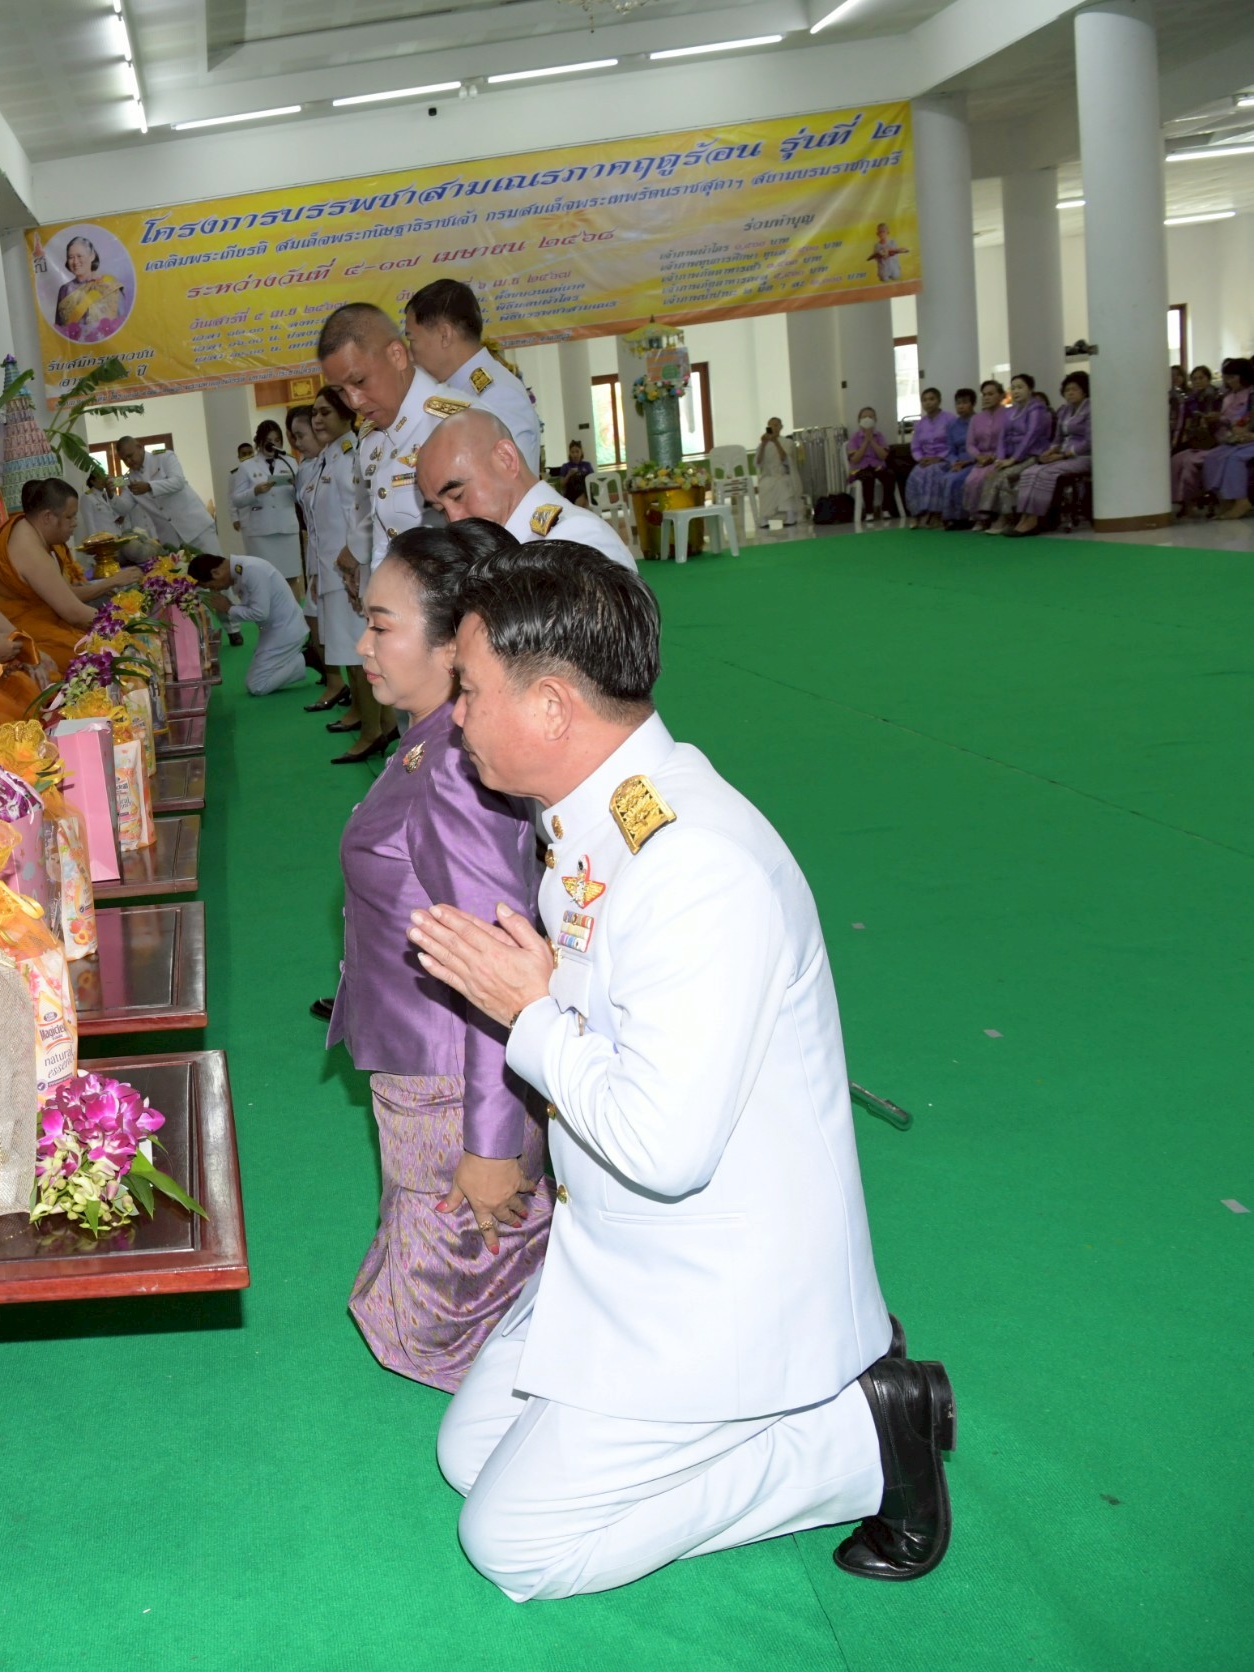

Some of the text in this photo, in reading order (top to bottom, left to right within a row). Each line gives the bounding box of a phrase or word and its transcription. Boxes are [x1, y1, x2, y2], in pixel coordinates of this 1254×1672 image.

[140, 114, 902, 246] โครงการบรรพชาสามเณรภาคฤดูร้อน รุ่นที่ ๒
[186, 258, 337, 299] ระหว่างวันที่
[432, 239, 527, 265] เมษายน
